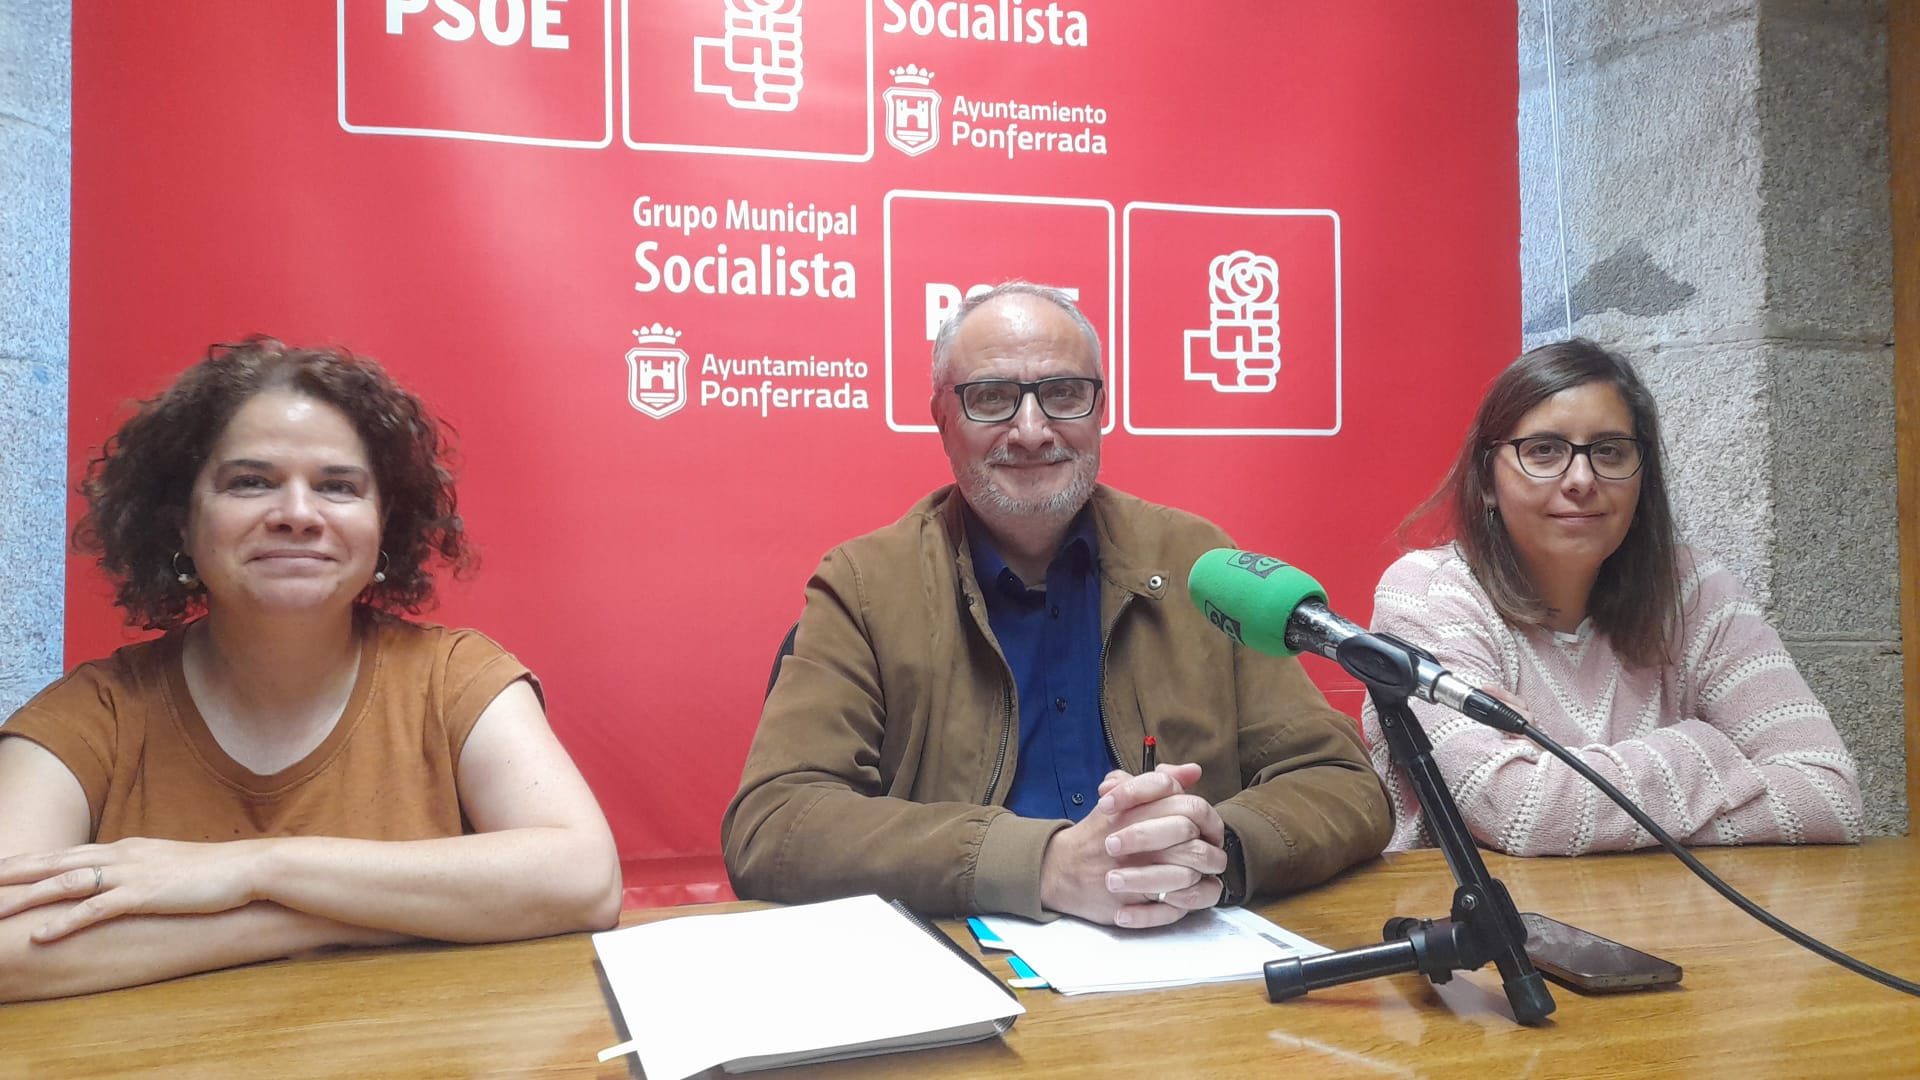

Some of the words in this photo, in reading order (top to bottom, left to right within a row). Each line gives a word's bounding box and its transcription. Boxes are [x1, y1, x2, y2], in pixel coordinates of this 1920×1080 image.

[883, 0, 1089, 47] Socialista
[952, 96, 1107, 124] Ayuntamiento
[952, 121, 1108, 159] Ponferrada
[633, 196, 718, 236] Grupo
[726, 199, 857, 241] Municipal
[635, 241, 857, 299] Socialista
[701, 354, 869, 381] Ayuntamiento
[701, 380, 869, 417] Ponferrada
